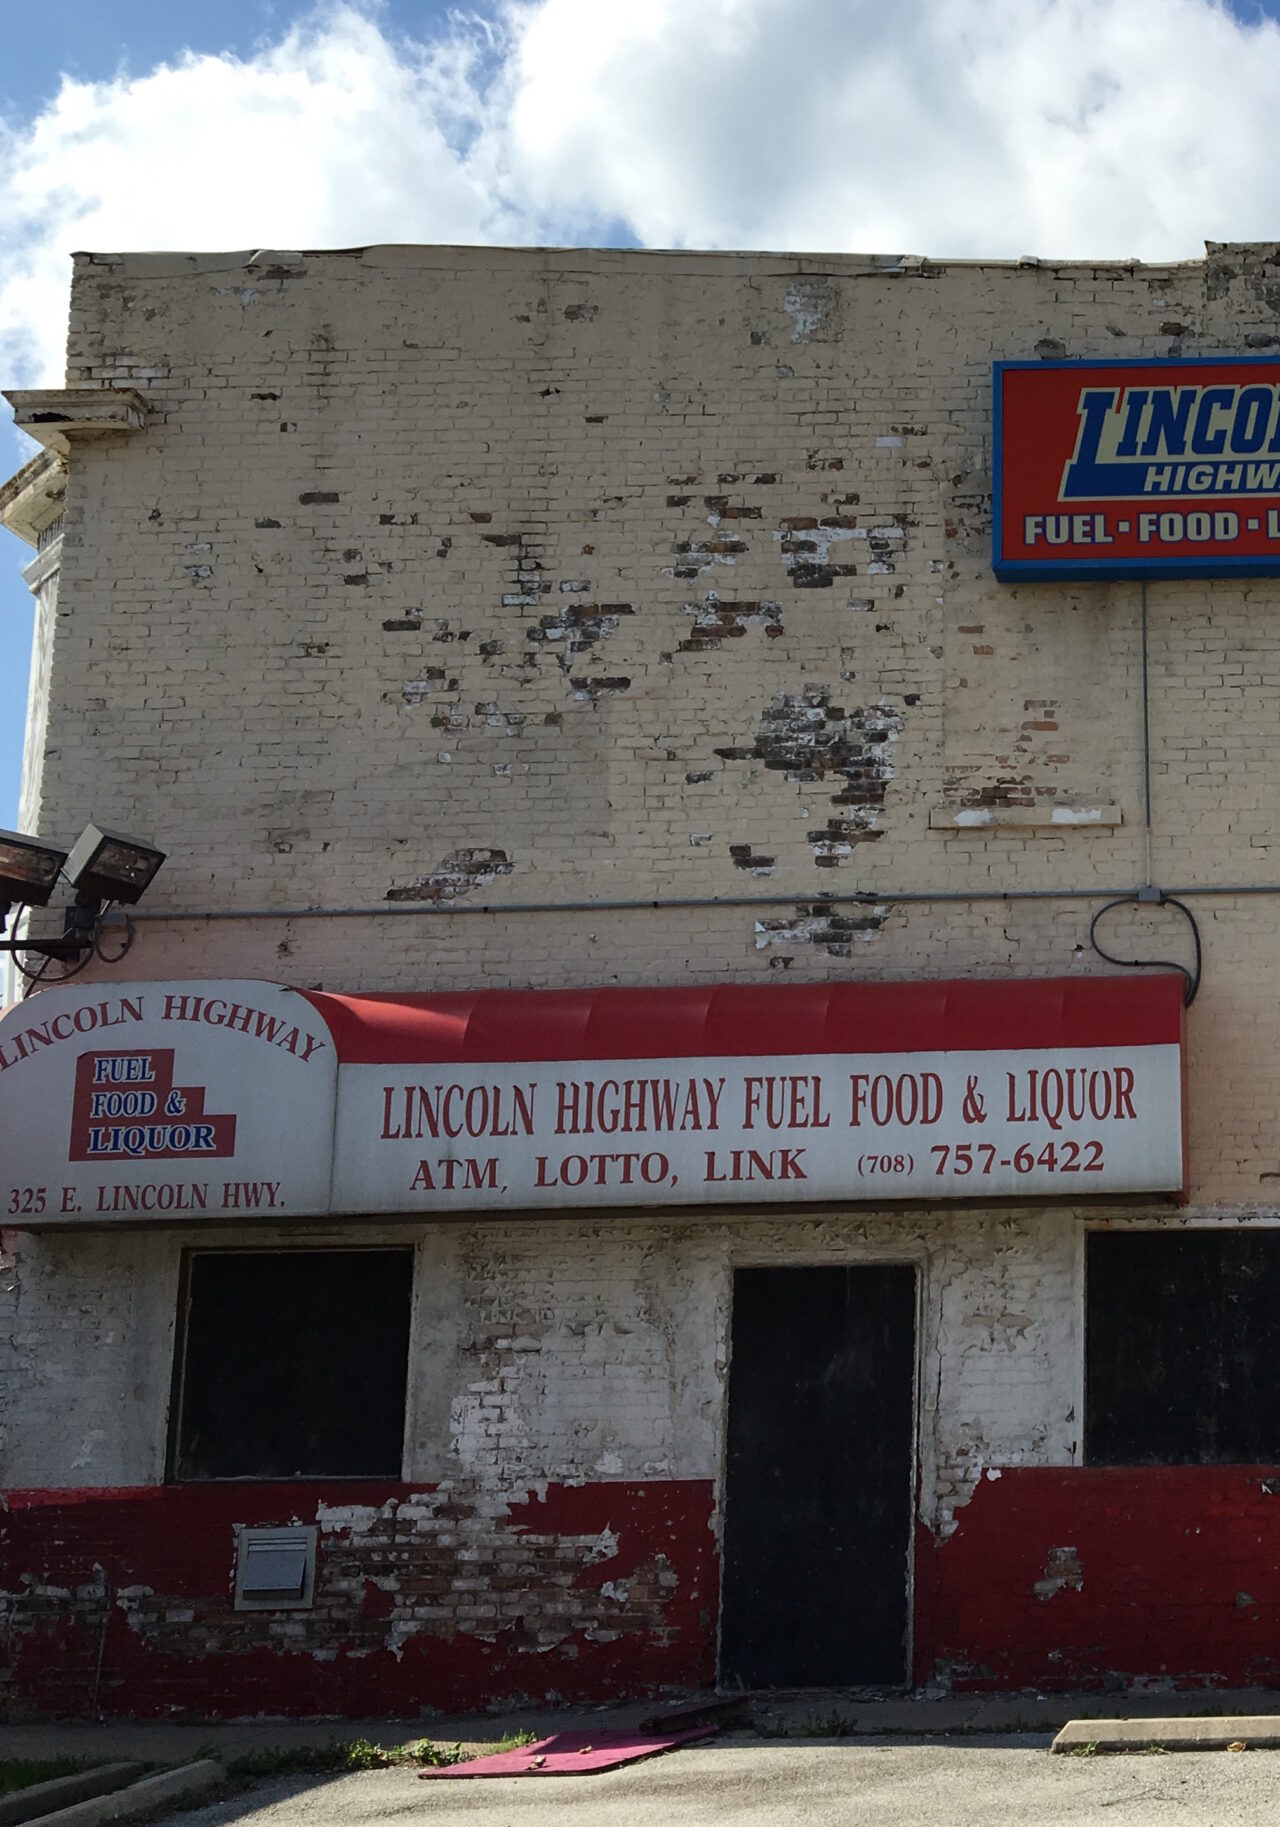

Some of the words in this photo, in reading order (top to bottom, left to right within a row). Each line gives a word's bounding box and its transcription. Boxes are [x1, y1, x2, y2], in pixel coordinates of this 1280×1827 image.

[1024, 515, 1114, 545] FUEL
[1138, 512, 1240, 542] FOOD
[0, 996, 145, 1072] LINCOLN
[161, 994, 326, 1063] HIGHWAY
[94, 1056, 155, 1083] FUEL
[90, 1091, 156, 1118] FOOD
[166, 1090, 186, 1116] &
[380, 1082, 538, 1140] LINCOLN
[554, 1077, 727, 1135] HIGHWAY
[742, 1076, 831, 1129] FUEL
[849, 1072, 944, 1127] FOOD
[961, 1074, 988, 1125] &
[1006, 1066, 1138, 1131] LIQUOR
[88, 1125, 216, 1153] LIQUOR
[409, 1158, 508, 1194] ATM,
[534, 1152, 679, 1188] LOTTO,
[703, 1148, 808, 1182] LINK
[856, 1154, 915, 1177] (708)
[930, 1140, 1105, 1175] 757-6422
[8, 1188, 47, 1214] 325
[60, 1187, 82, 1213] E.
[96, 1183, 208, 1212] LINCOLN
[222, 1182, 285, 1208] HWY.
